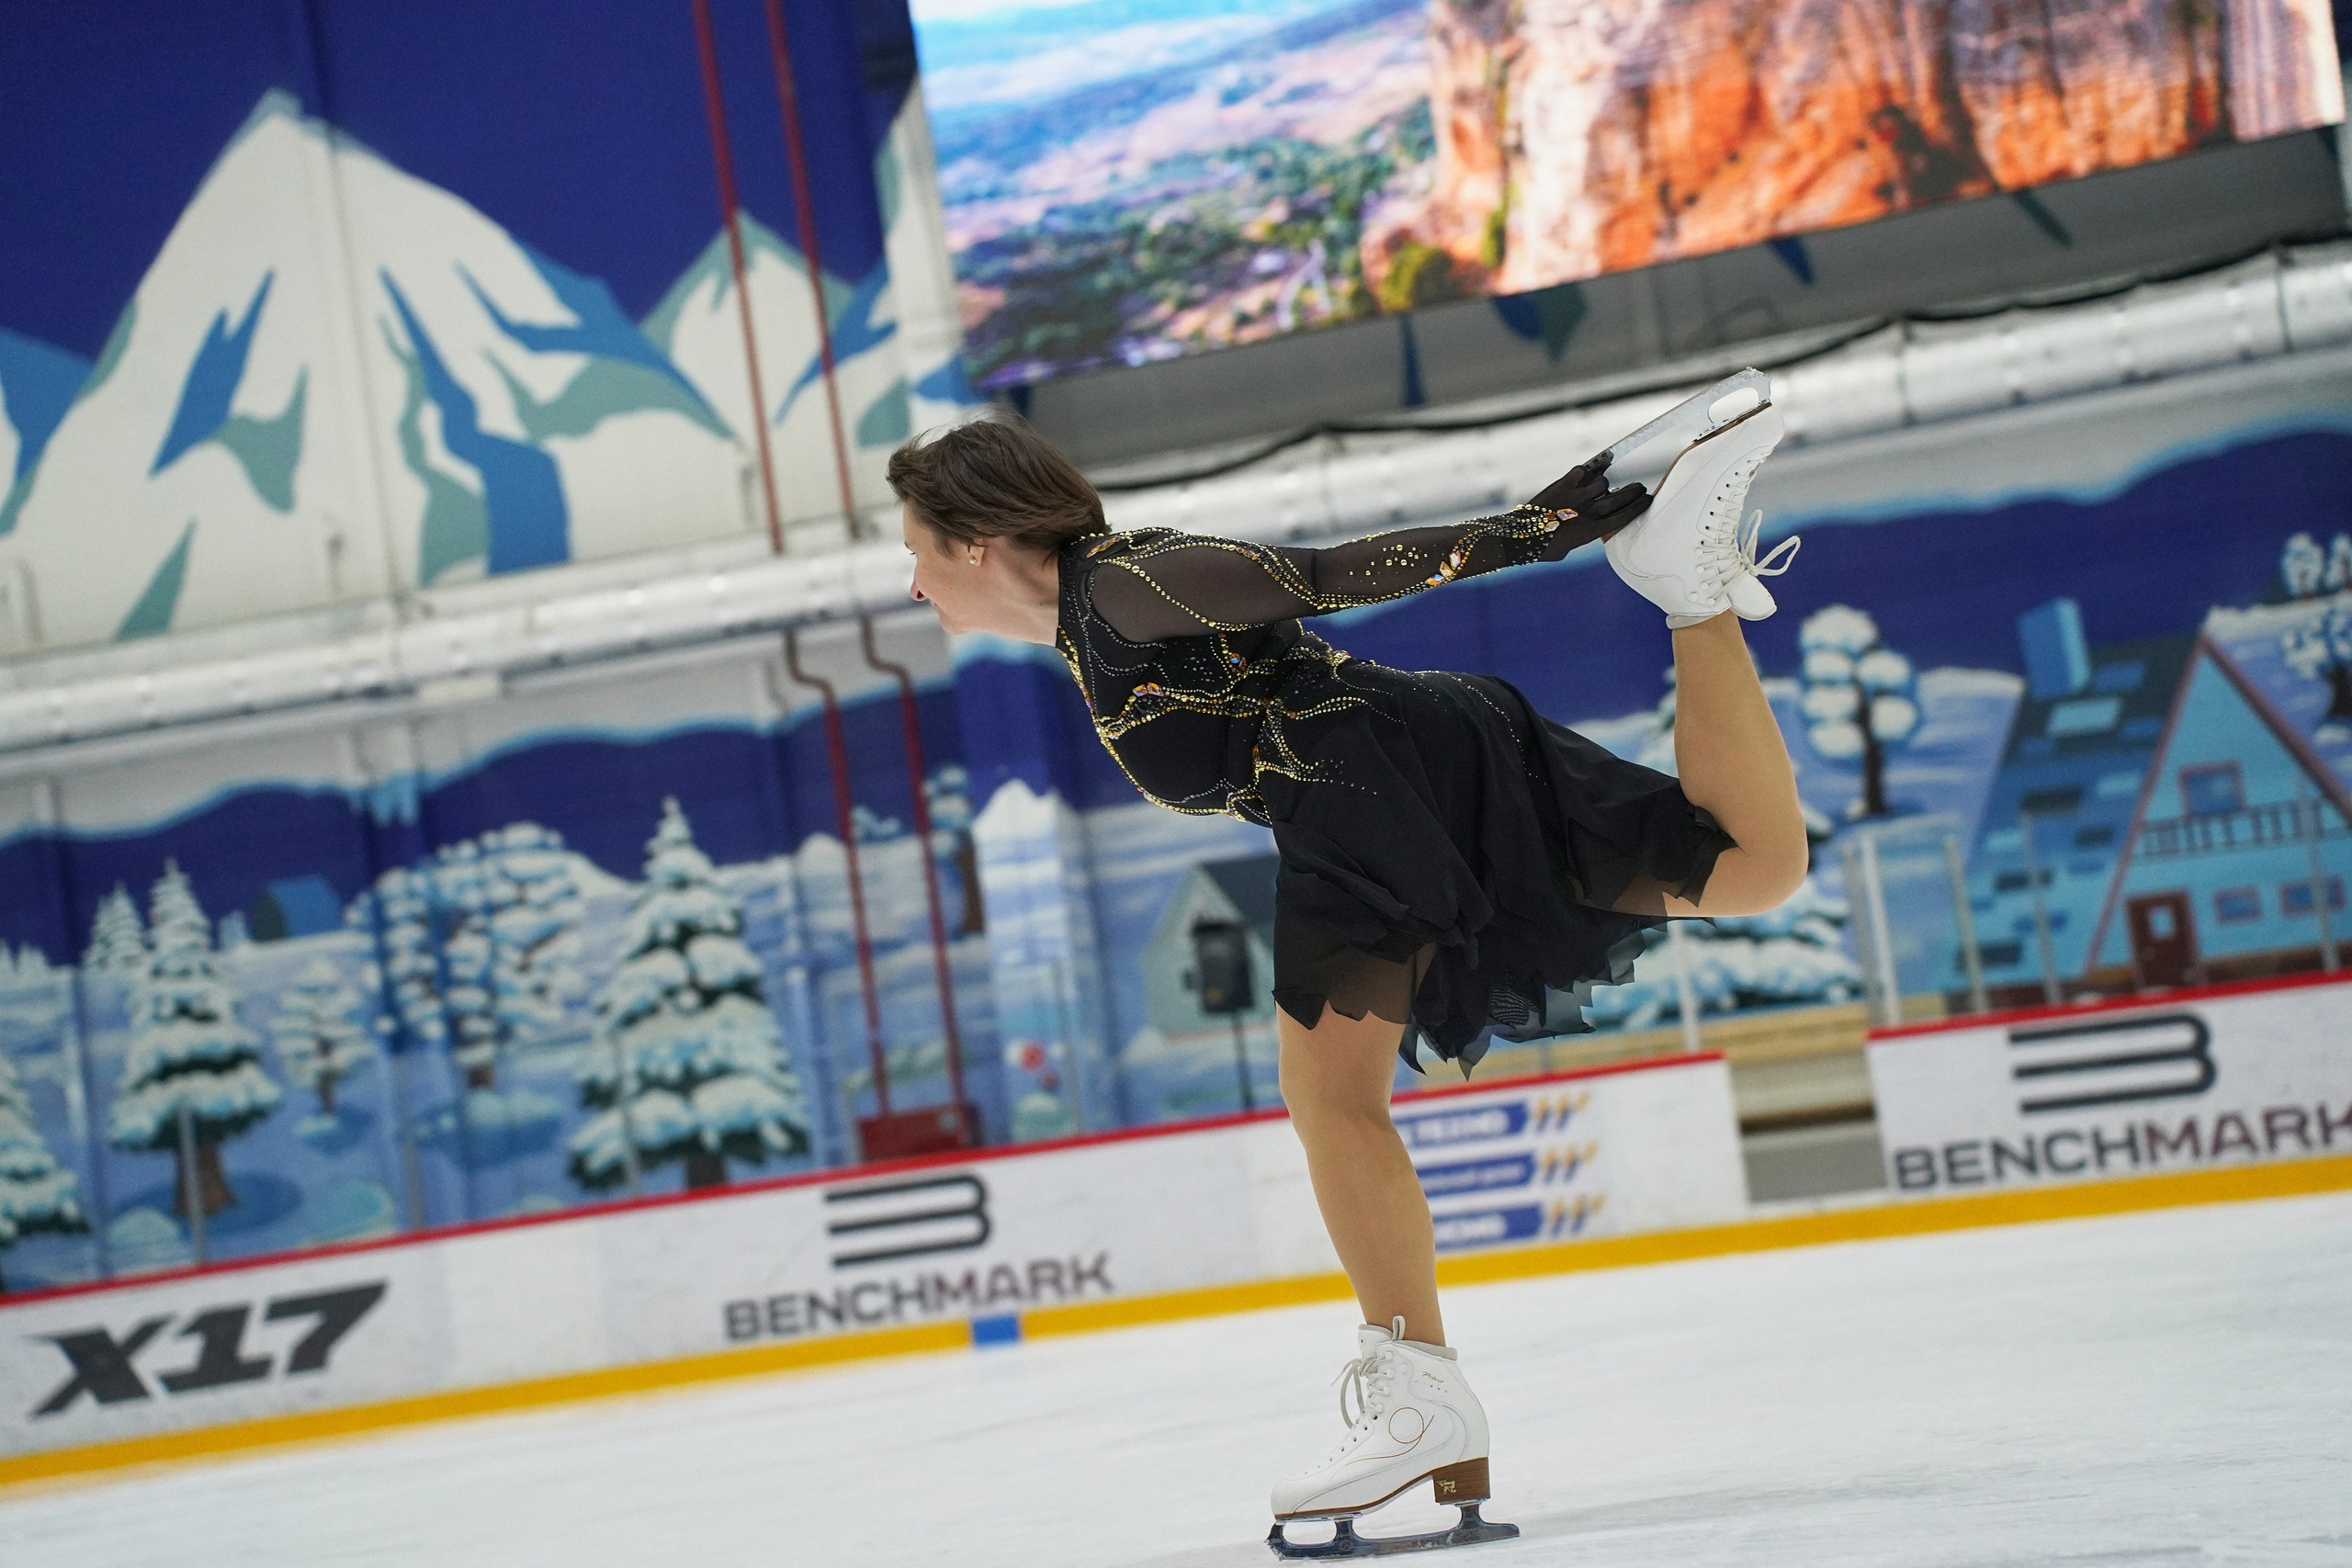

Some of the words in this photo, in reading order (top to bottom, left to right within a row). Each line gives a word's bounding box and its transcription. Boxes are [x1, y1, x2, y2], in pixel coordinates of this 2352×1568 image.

[1894, 1101, 2352, 1191] BENCHMARK
[723, 1253, 1114, 1340] BENCHMARK
[27, 1279, 388, 1419] X17
